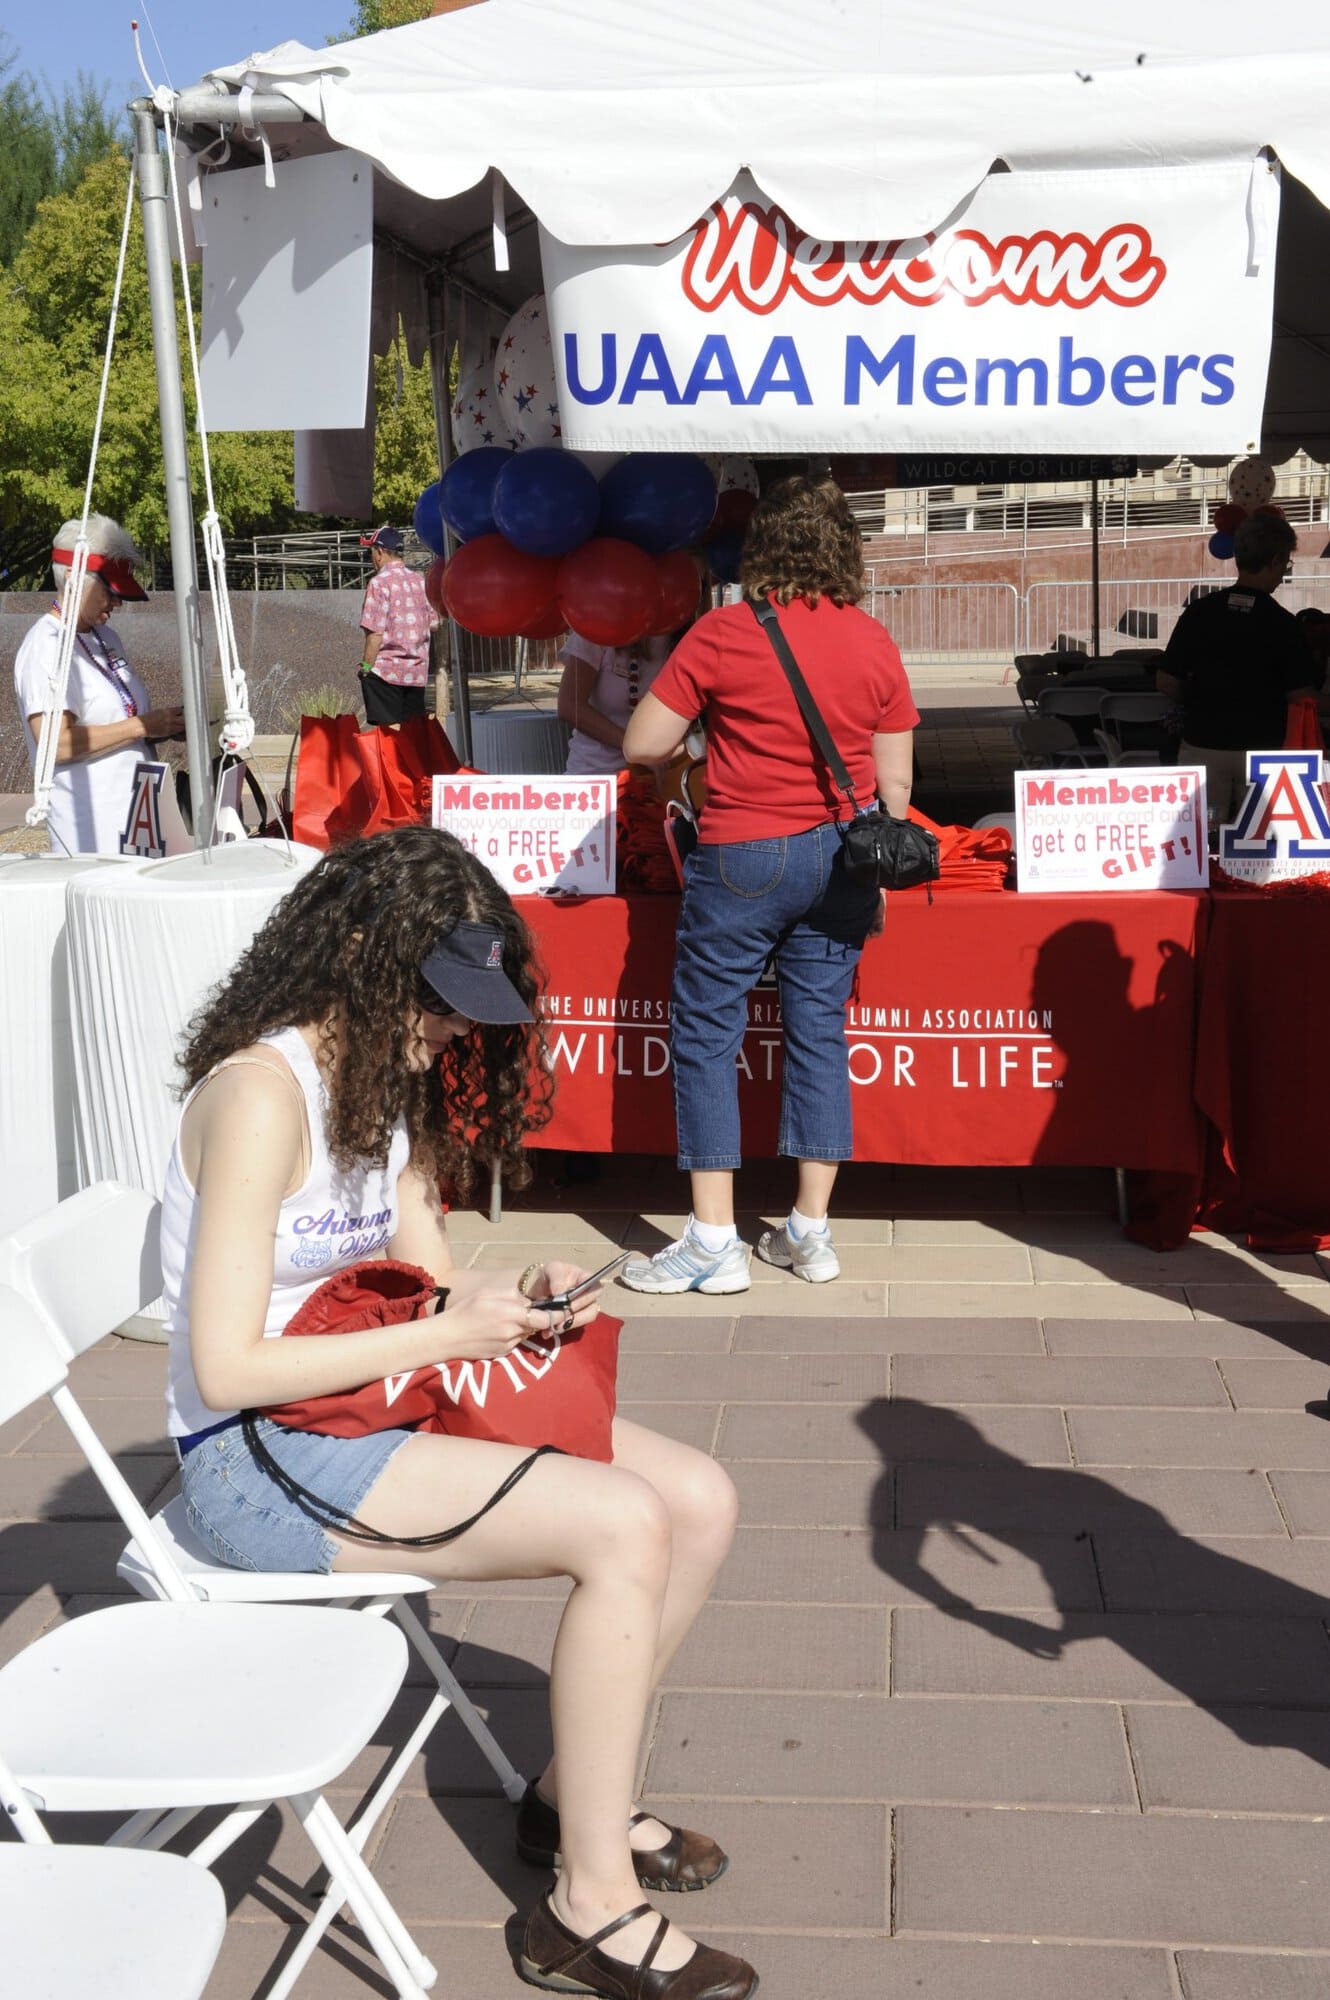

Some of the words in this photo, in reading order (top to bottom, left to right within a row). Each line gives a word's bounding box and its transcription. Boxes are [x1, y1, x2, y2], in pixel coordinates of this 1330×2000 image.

[668, 197, 1167, 316] Welcome
[563, 333, 814, 407] UAAA
[843, 334, 1237, 408] Members
[904, 461, 998, 480] WILDCAT
[1007, 459, 1048, 476] FOR
[1059, 458, 1098, 476] LIFE
[443, 784, 601, 812] Members!
[1026, 776, 1190, 806] Members!
[488, 815, 526, 834] your
[529, 811, 565, 830] card
[1026, 808, 1070, 827] Show
[1074, 811, 1112, 829] your
[1118, 806, 1155, 825] card
[1160, 805, 1193, 824] and
[460, 832, 478, 856] et
[487, 837, 499, 857] a
[508, 830, 560, 857] FREE
[1032, 828, 1065, 859] get
[1075, 833, 1086, 853] a
[1096, 824, 1149, 852] FREE
[513, 843, 601, 883] GIFT!
[1102, 836, 1192, 879] GIFT!
[584, 996, 671, 1020] UNIVERSI
[849, 1006, 910, 1028] LUMNI
[922, 1008, 1052, 1030] ASSOCIATION
[847, 1043, 917, 1087] OR
[952, 1045, 1053, 1089] LIFE
[293, 1208, 392, 1235] Arizona
